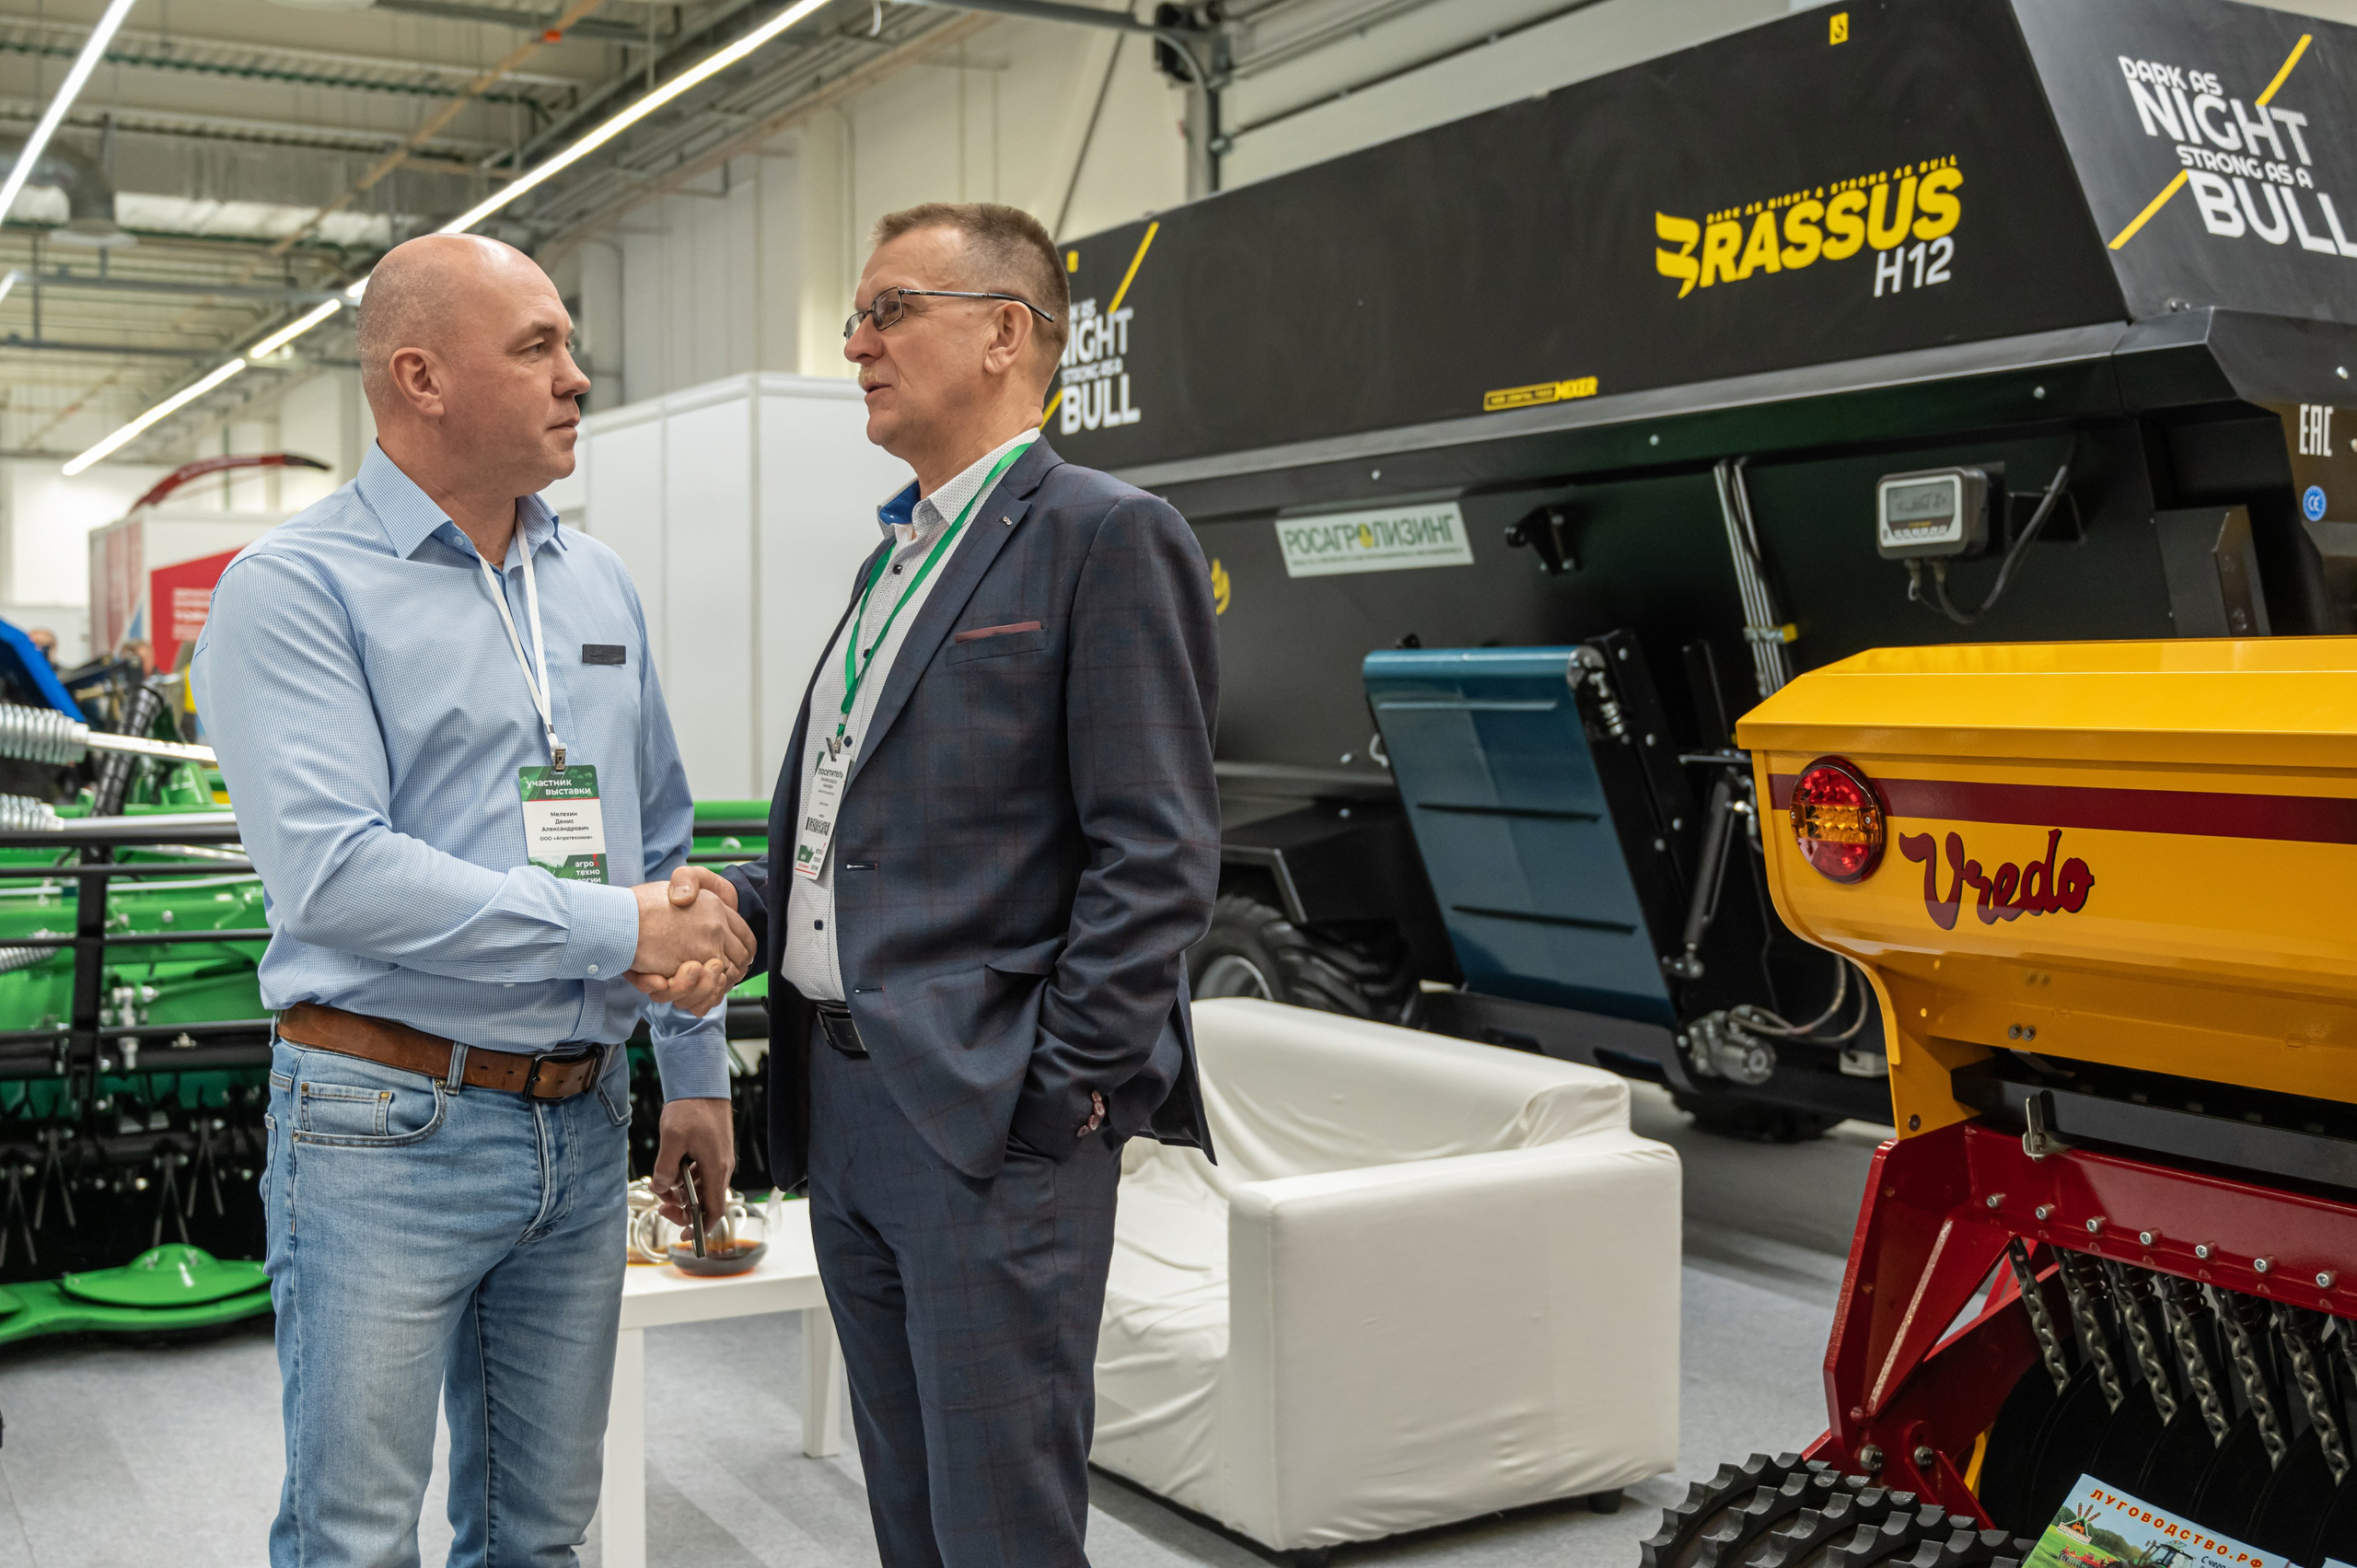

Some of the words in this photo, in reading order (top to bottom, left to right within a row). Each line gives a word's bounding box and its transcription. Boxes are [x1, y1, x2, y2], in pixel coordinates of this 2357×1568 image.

[2118, 55, 2188, 90] DARK
[2189, 70, 2223, 96] AS
[2127, 79, 2312, 166] NIGHT
[1706, 206, 1741, 225] DARK
[1746, 201, 1762, 215] AS
[1768, 189, 1810, 210] NIGHT
[1830, 170, 1887, 195] STRONG
[1893, 165, 1912, 180] AS
[1919, 154, 1957, 174] BULL
[2176, 145, 2262, 180] STRONG
[2265, 161, 2294, 185] AS
[2295, 168, 2314, 189] A
[2186, 168, 2357, 259] BULL
[1874, 236, 1954, 297] H12
[1061, 373, 1141, 436] BULL
[1283, 515, 1454, 554] РОСАГРОЛИЗИНГ
[527, 779, 572, 789] участник
[545, 787, 591, 796] выставки
[1898, 829, 2096, 931] Vredo
[2090, 1488, 2264, 1568] ЛУГОВОДСТВО.РФ
